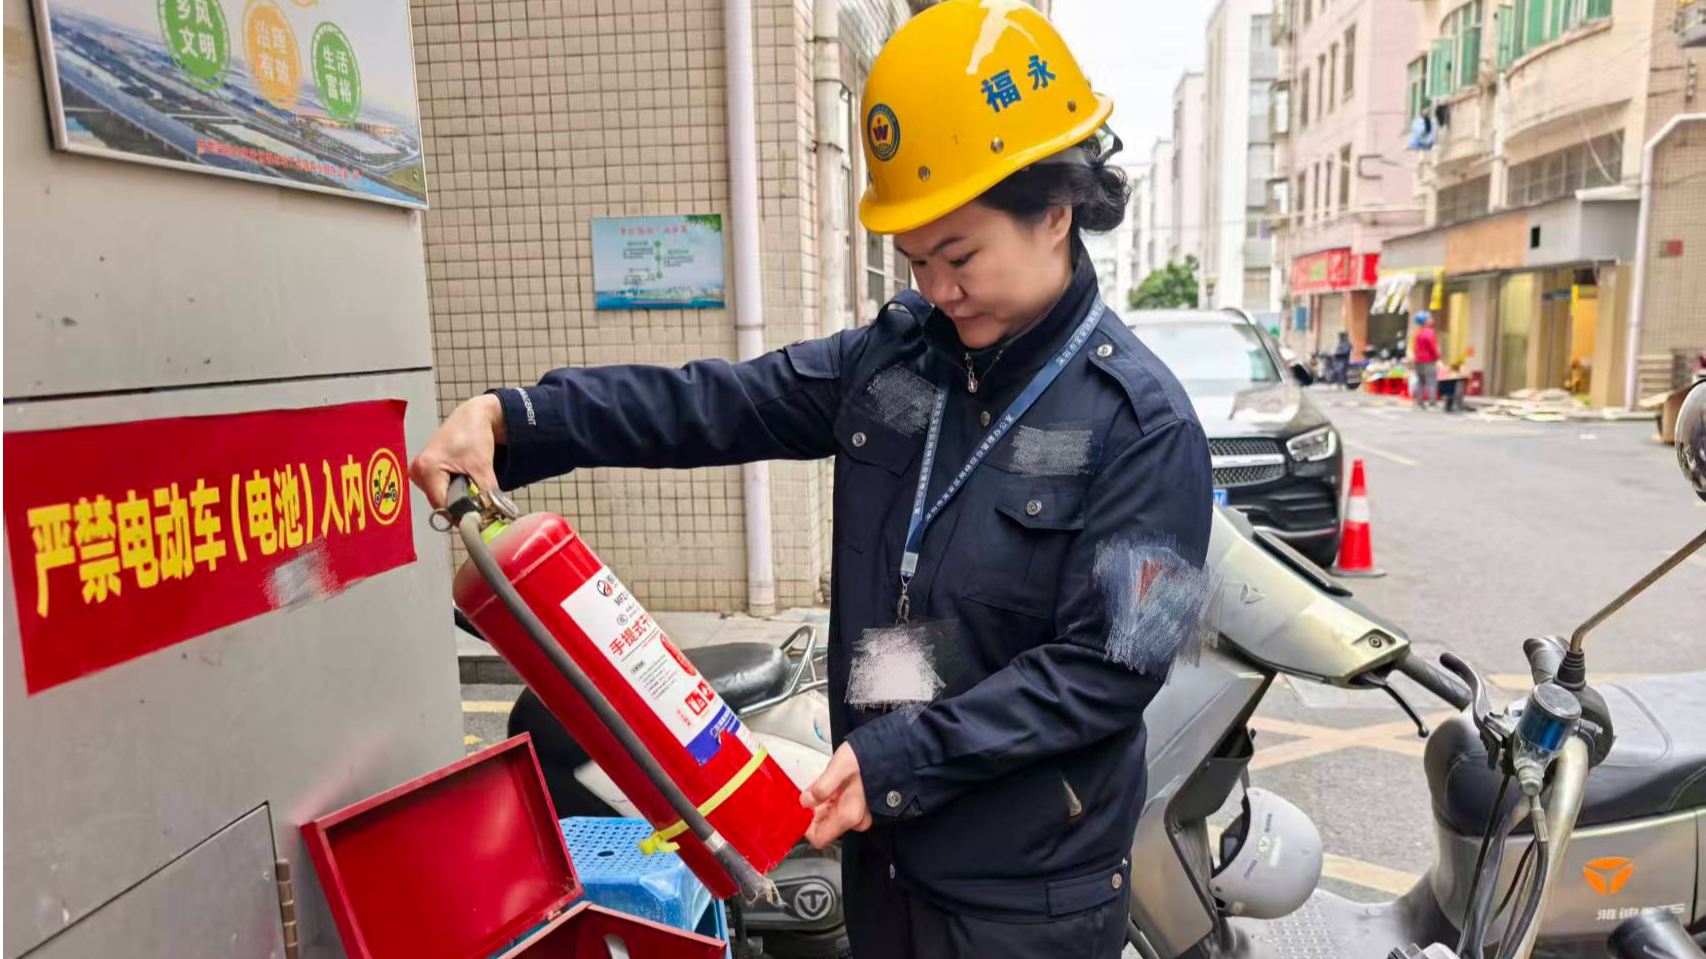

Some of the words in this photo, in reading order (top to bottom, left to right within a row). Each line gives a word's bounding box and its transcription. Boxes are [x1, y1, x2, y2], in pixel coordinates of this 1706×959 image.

[179, 27, 217, 63] 文明
[257, 20, 288, 54] 治理
[322, 44, 349, 76] 生活
[981, 54, 1056, 113] 福永
